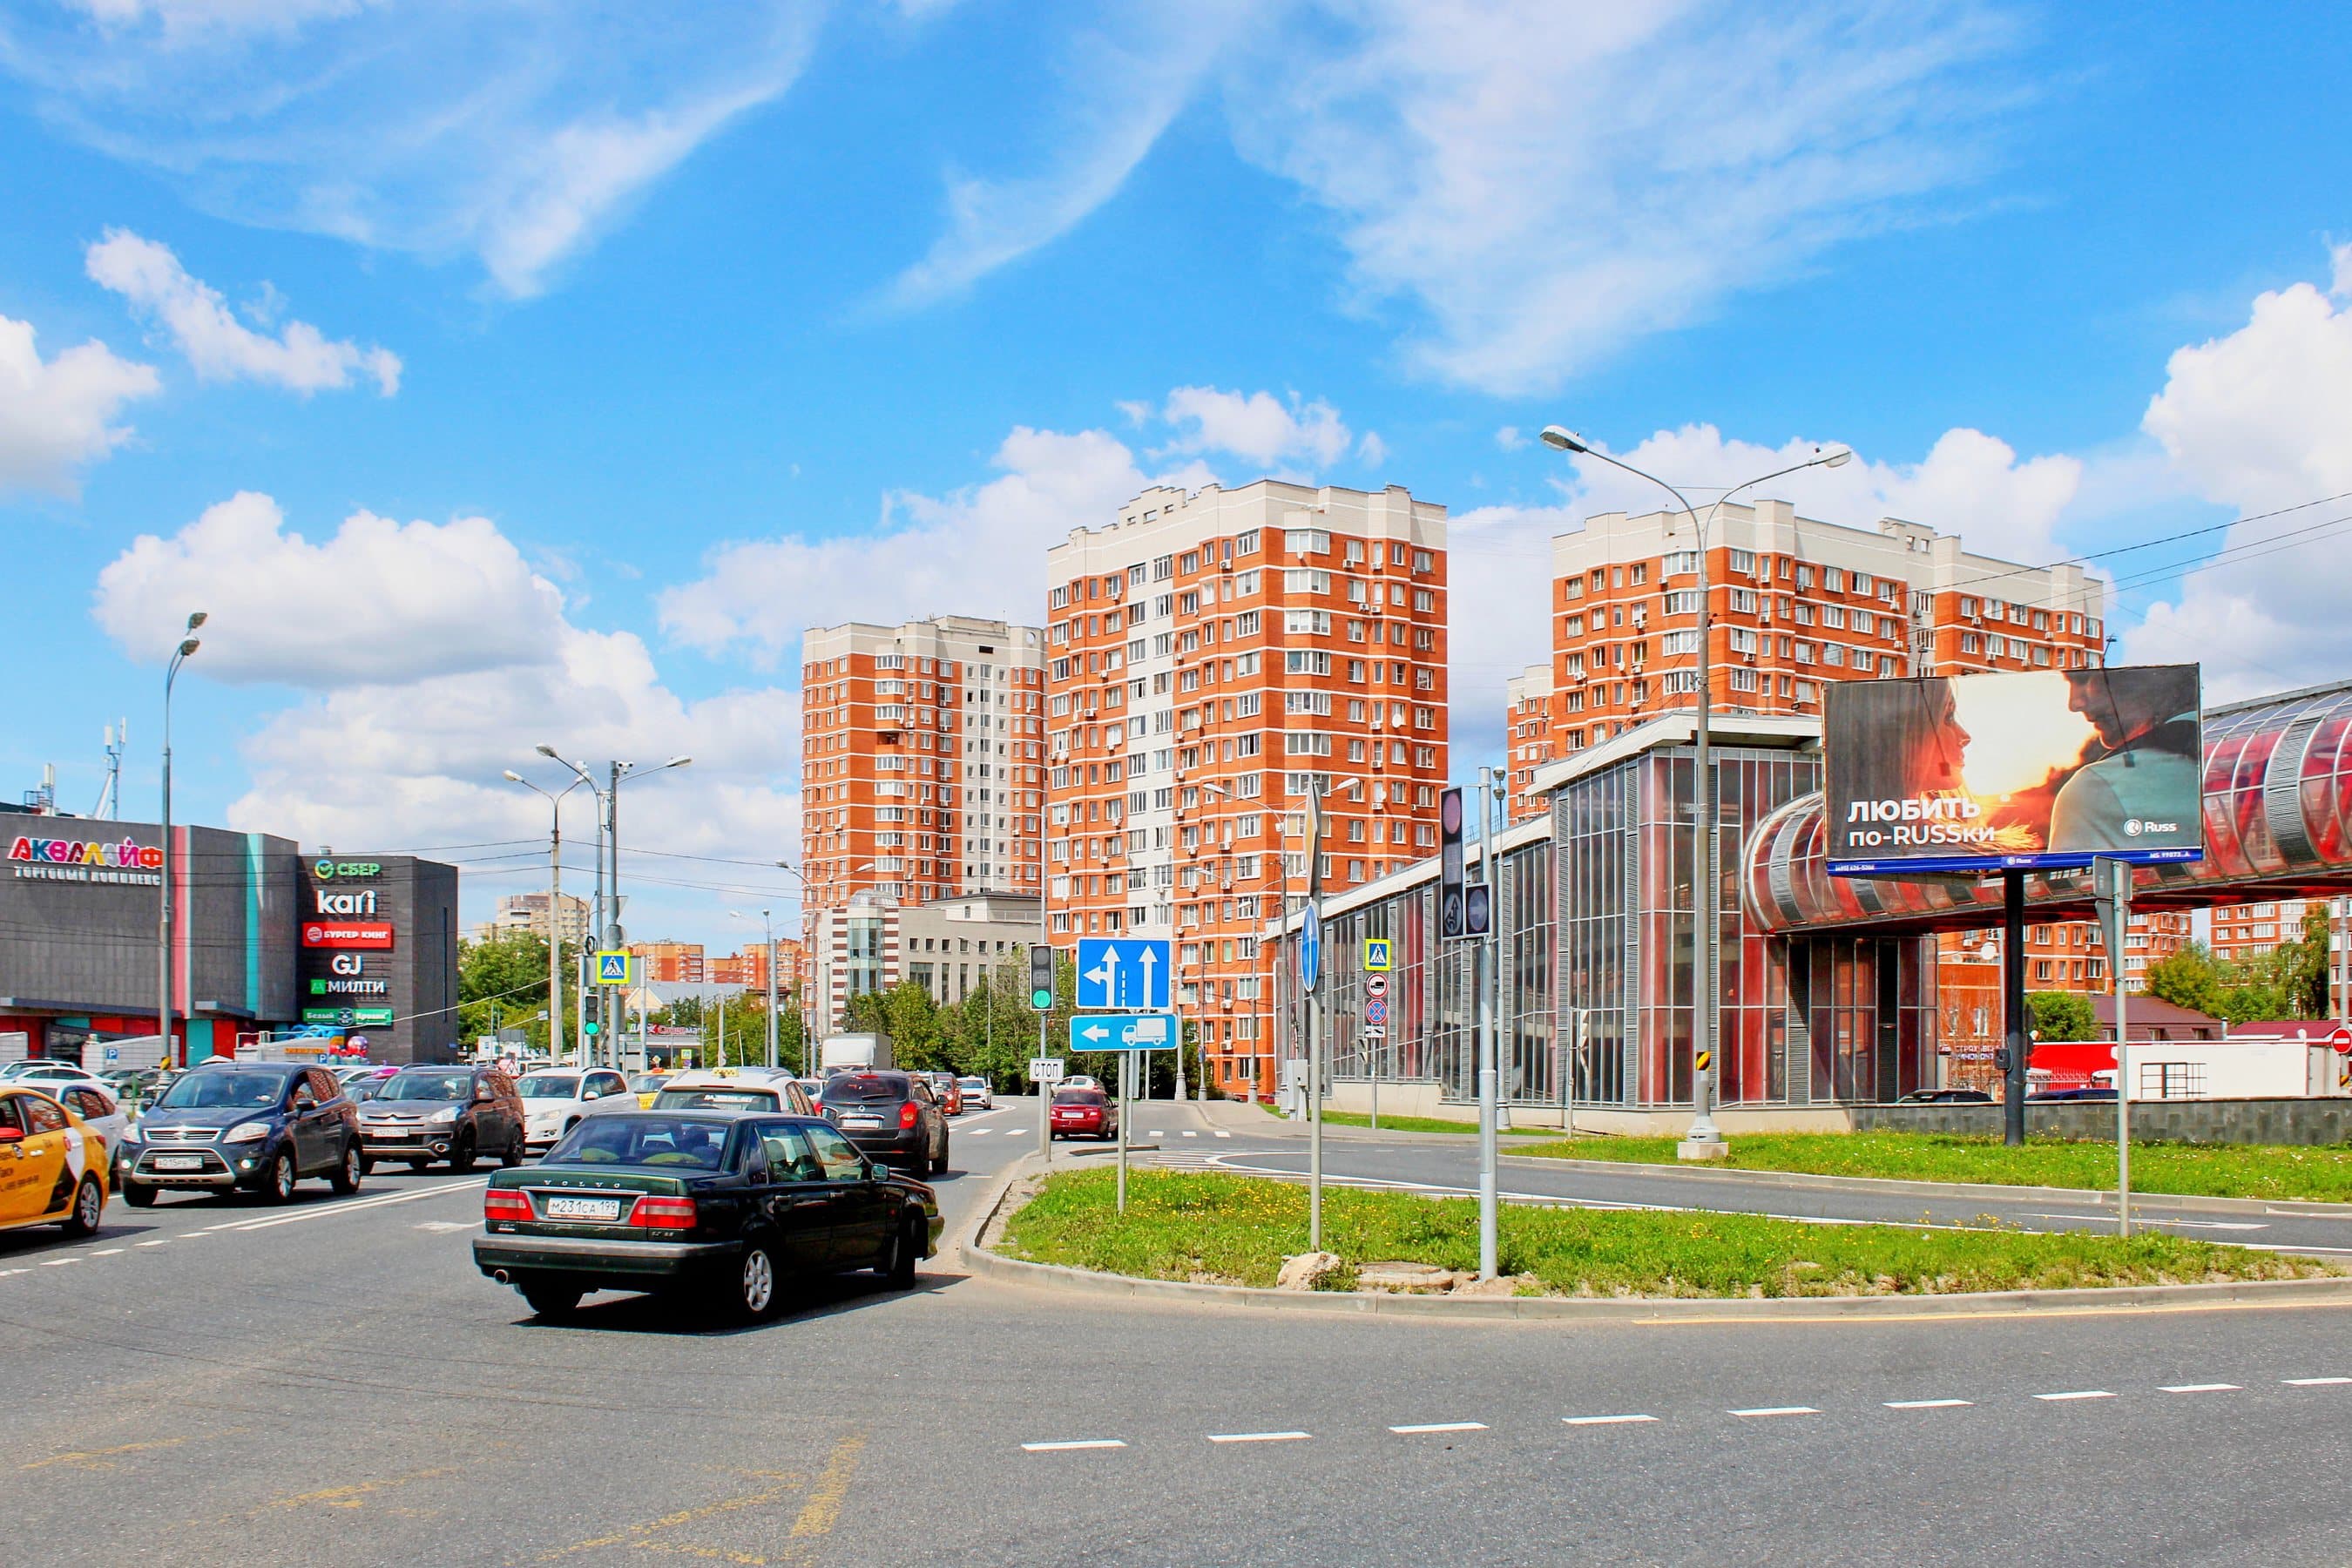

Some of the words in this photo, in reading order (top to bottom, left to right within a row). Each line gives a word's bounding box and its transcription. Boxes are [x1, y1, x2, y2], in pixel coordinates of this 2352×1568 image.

[1848, 798, 1981, 822] ЛЮБИТЬ
[1848, 824, 1995, 847] по-RUSSки
[2144, 821, 2177, 833] Russ
[7, 836, 163, 868] АКВАЛАЙФ
[14, 866, 87, 882] ТОРГОВЫЙ
[91, 872, 161, 886] КОМПЛЕКС
[337, 862, 382, 876] СБЕР
[317, 889, 375, 914] kari
[323, 930, 359, 939] БУРГЕР
[362, 930, 388, 939] КИНГ
[332, 954, 362, 975] GJ
[328, 981, 385, 993] МИЛТИ
[1034, 1063, 1058, 1078] СТОП
[544, 1179, 620, 1189] VOLVO
